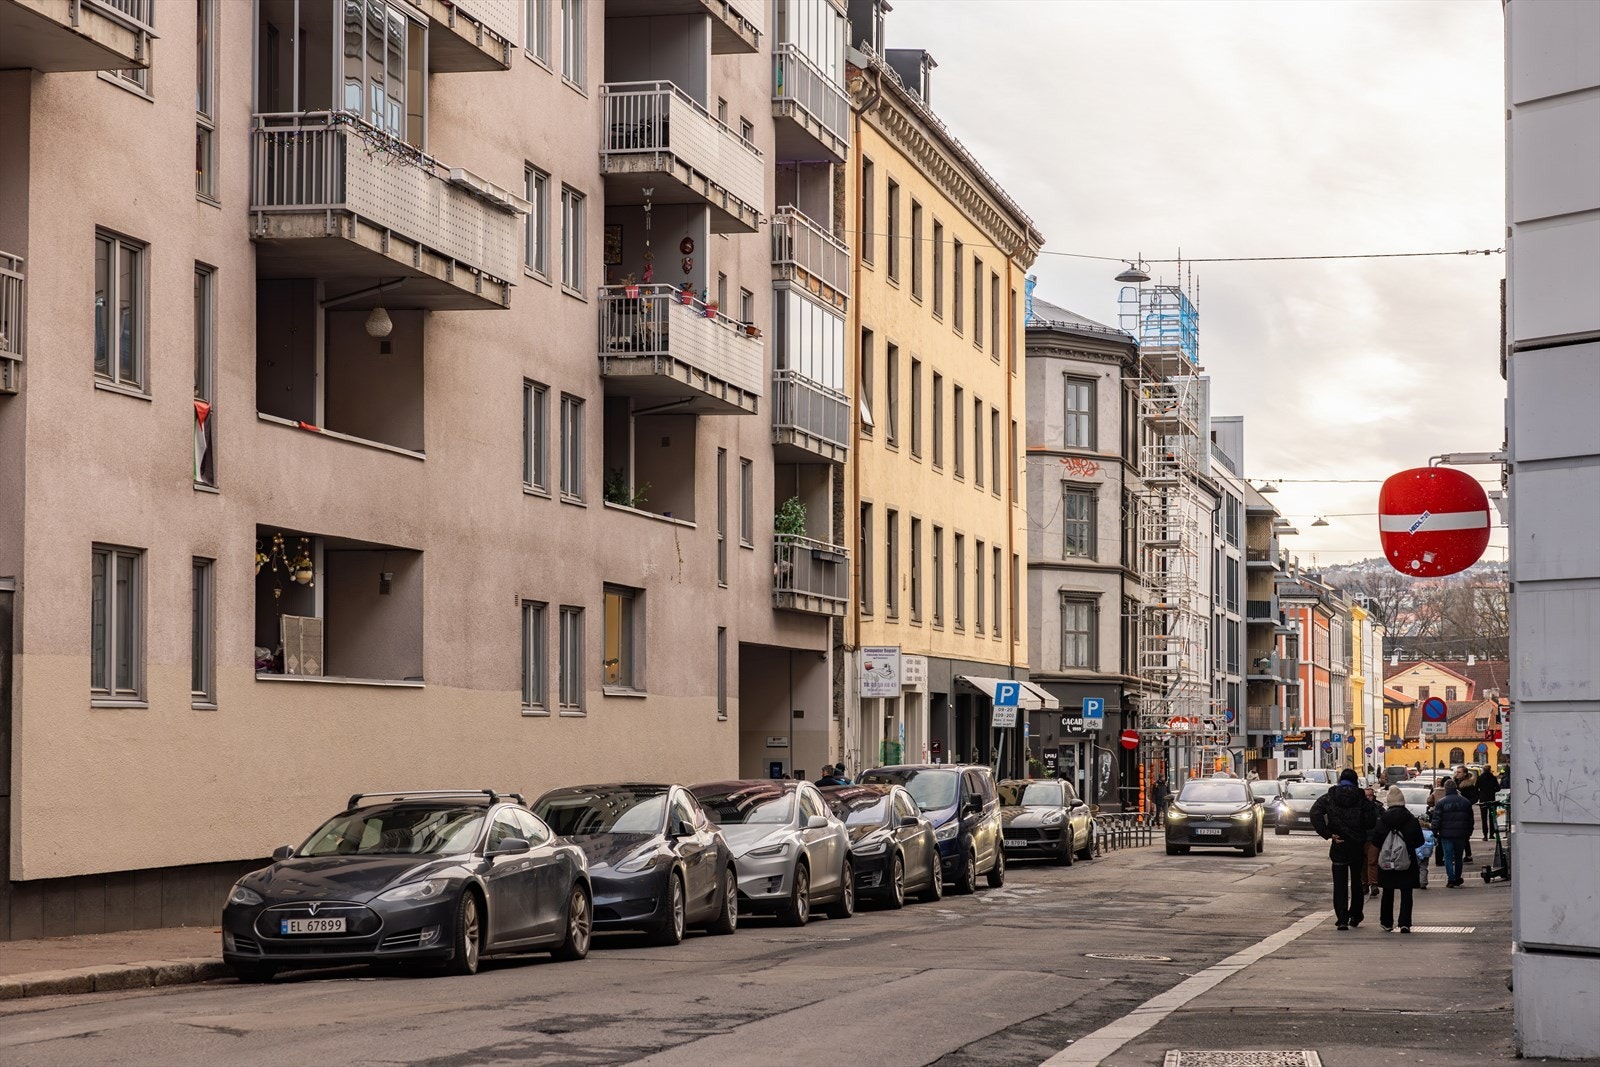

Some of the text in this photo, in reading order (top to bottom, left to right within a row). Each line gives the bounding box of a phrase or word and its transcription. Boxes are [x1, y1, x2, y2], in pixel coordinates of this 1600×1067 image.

[1000, 686, 1014, 704] P
[1088, 700, 1098, 716] P
[290, 920, 342, 932] EL 67899
